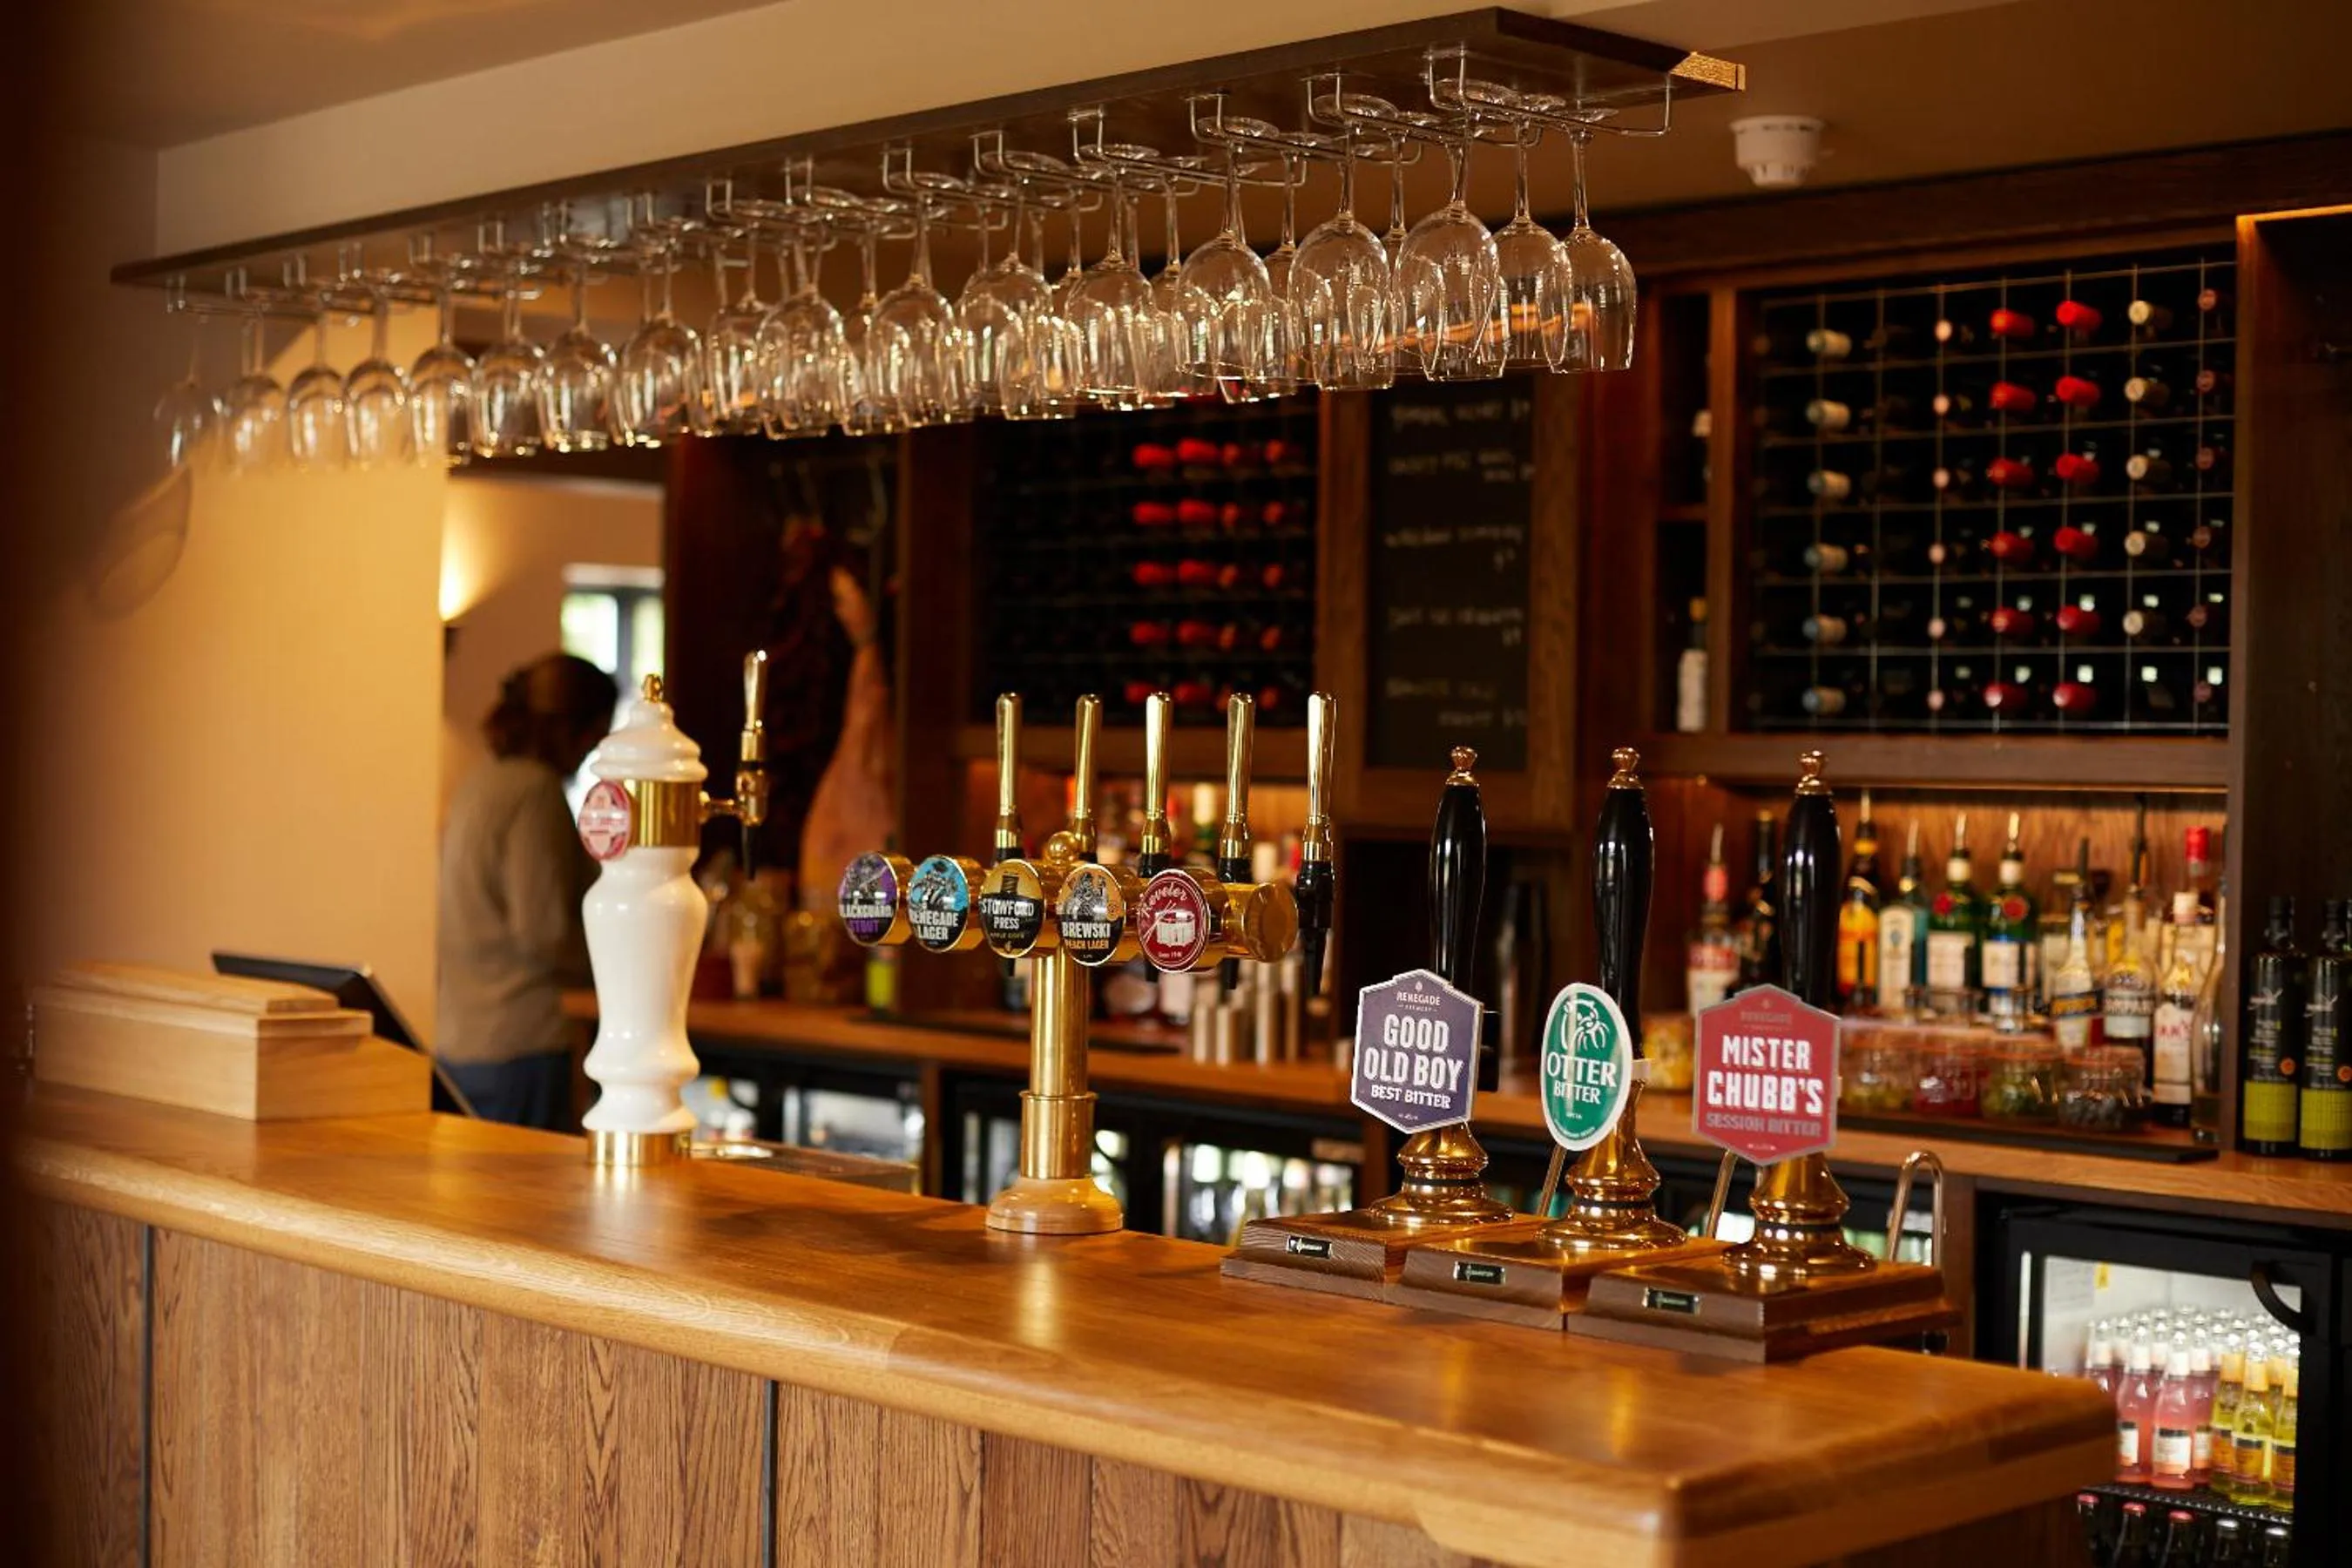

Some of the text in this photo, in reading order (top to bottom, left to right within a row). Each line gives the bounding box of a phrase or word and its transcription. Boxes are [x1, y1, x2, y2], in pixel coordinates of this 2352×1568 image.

[909, 908, 959, 927] RENEGADE
[981, 898, 1034, 916] STOWFORD
[917, 924, 950, 940] LAGER
[993, 916, 1020, 929] PRESS
[1062, 922, 1112, 938] BREWSKI
[1064, 938, 1110, 950] PEACH LAGER
[1396, 991, 1441, 1006] RENEGADE
[1383, 1013, 1450, 1053] GOOD
[1721, 1034, 1811, 1071] MISTER
[1363, 1047, 1463, 1092] OLD BOY
[1546, 1051, 1617, 1088] OTTER
[1371, 1084, 1451, 1109] BEST BITTER
[1553, 1080, 1600, 1105] BITTER
[1707, 1070, 1824, 1115] CHUBB'S
[1706, 1112, 1822, 1137] SESSION BITTER
